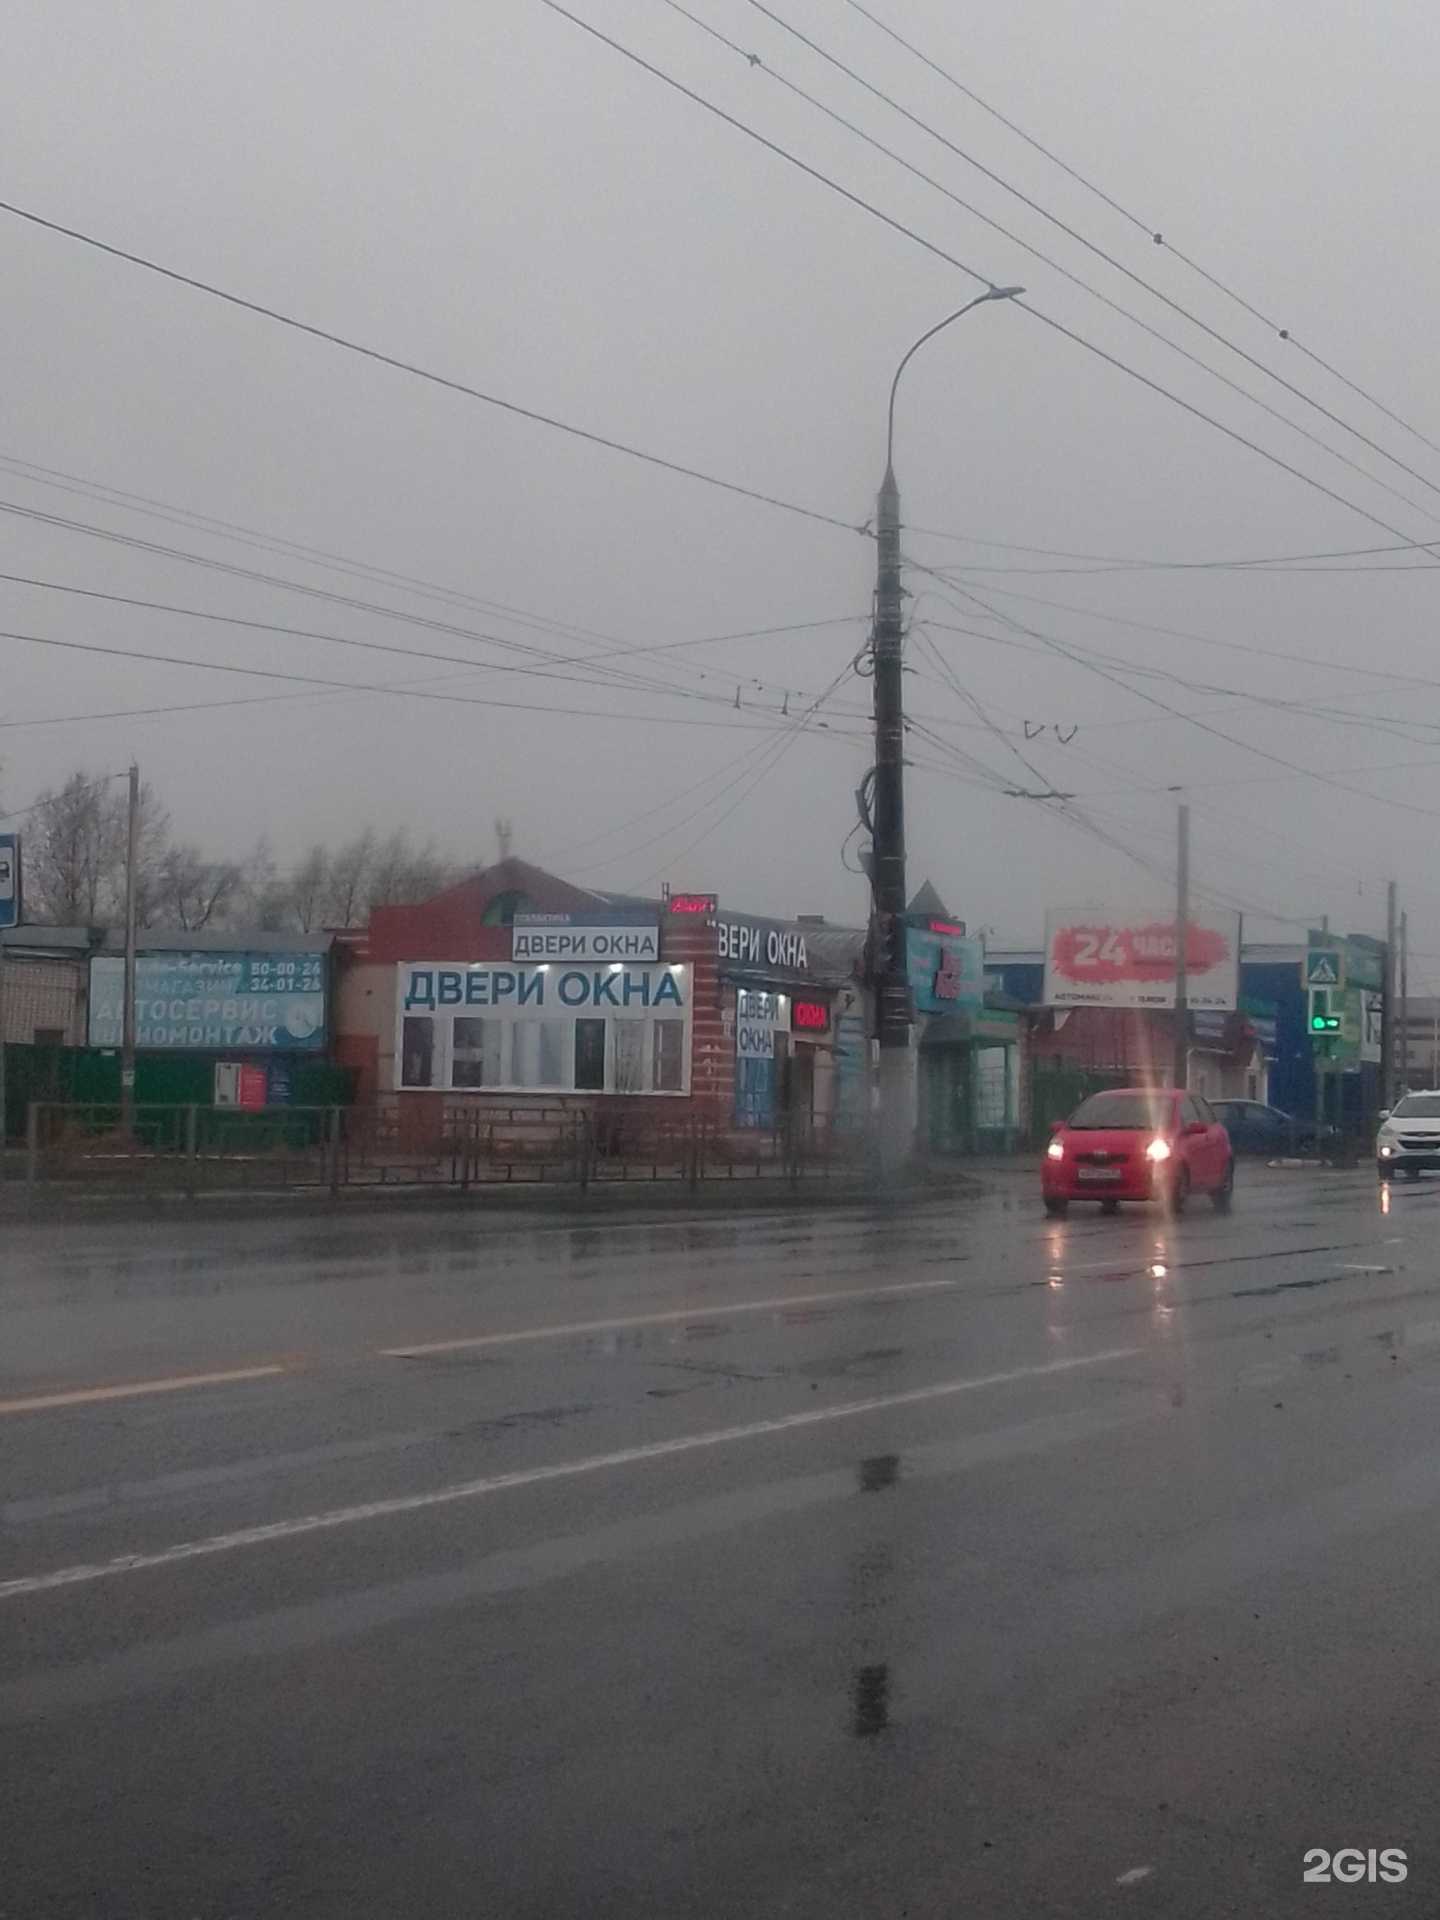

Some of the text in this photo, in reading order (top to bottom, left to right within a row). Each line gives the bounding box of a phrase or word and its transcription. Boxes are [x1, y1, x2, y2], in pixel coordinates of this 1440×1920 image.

[514, 935, 655, 957] ДВЕРИ ОКНА
[707, 920, 808, 968] ВЕРИ ОКНА
[1073, 934, 1178, 966] 24 ЧАС
[404, 971, 683, 1011] ДВЕРИ ОКНА
[739, 992, 779, 1021] ДВЕРИ
[94, 1026, 278, 1045] ШНОМОНТАЖ
[739, 1027, 771, 1053] ОКНА
